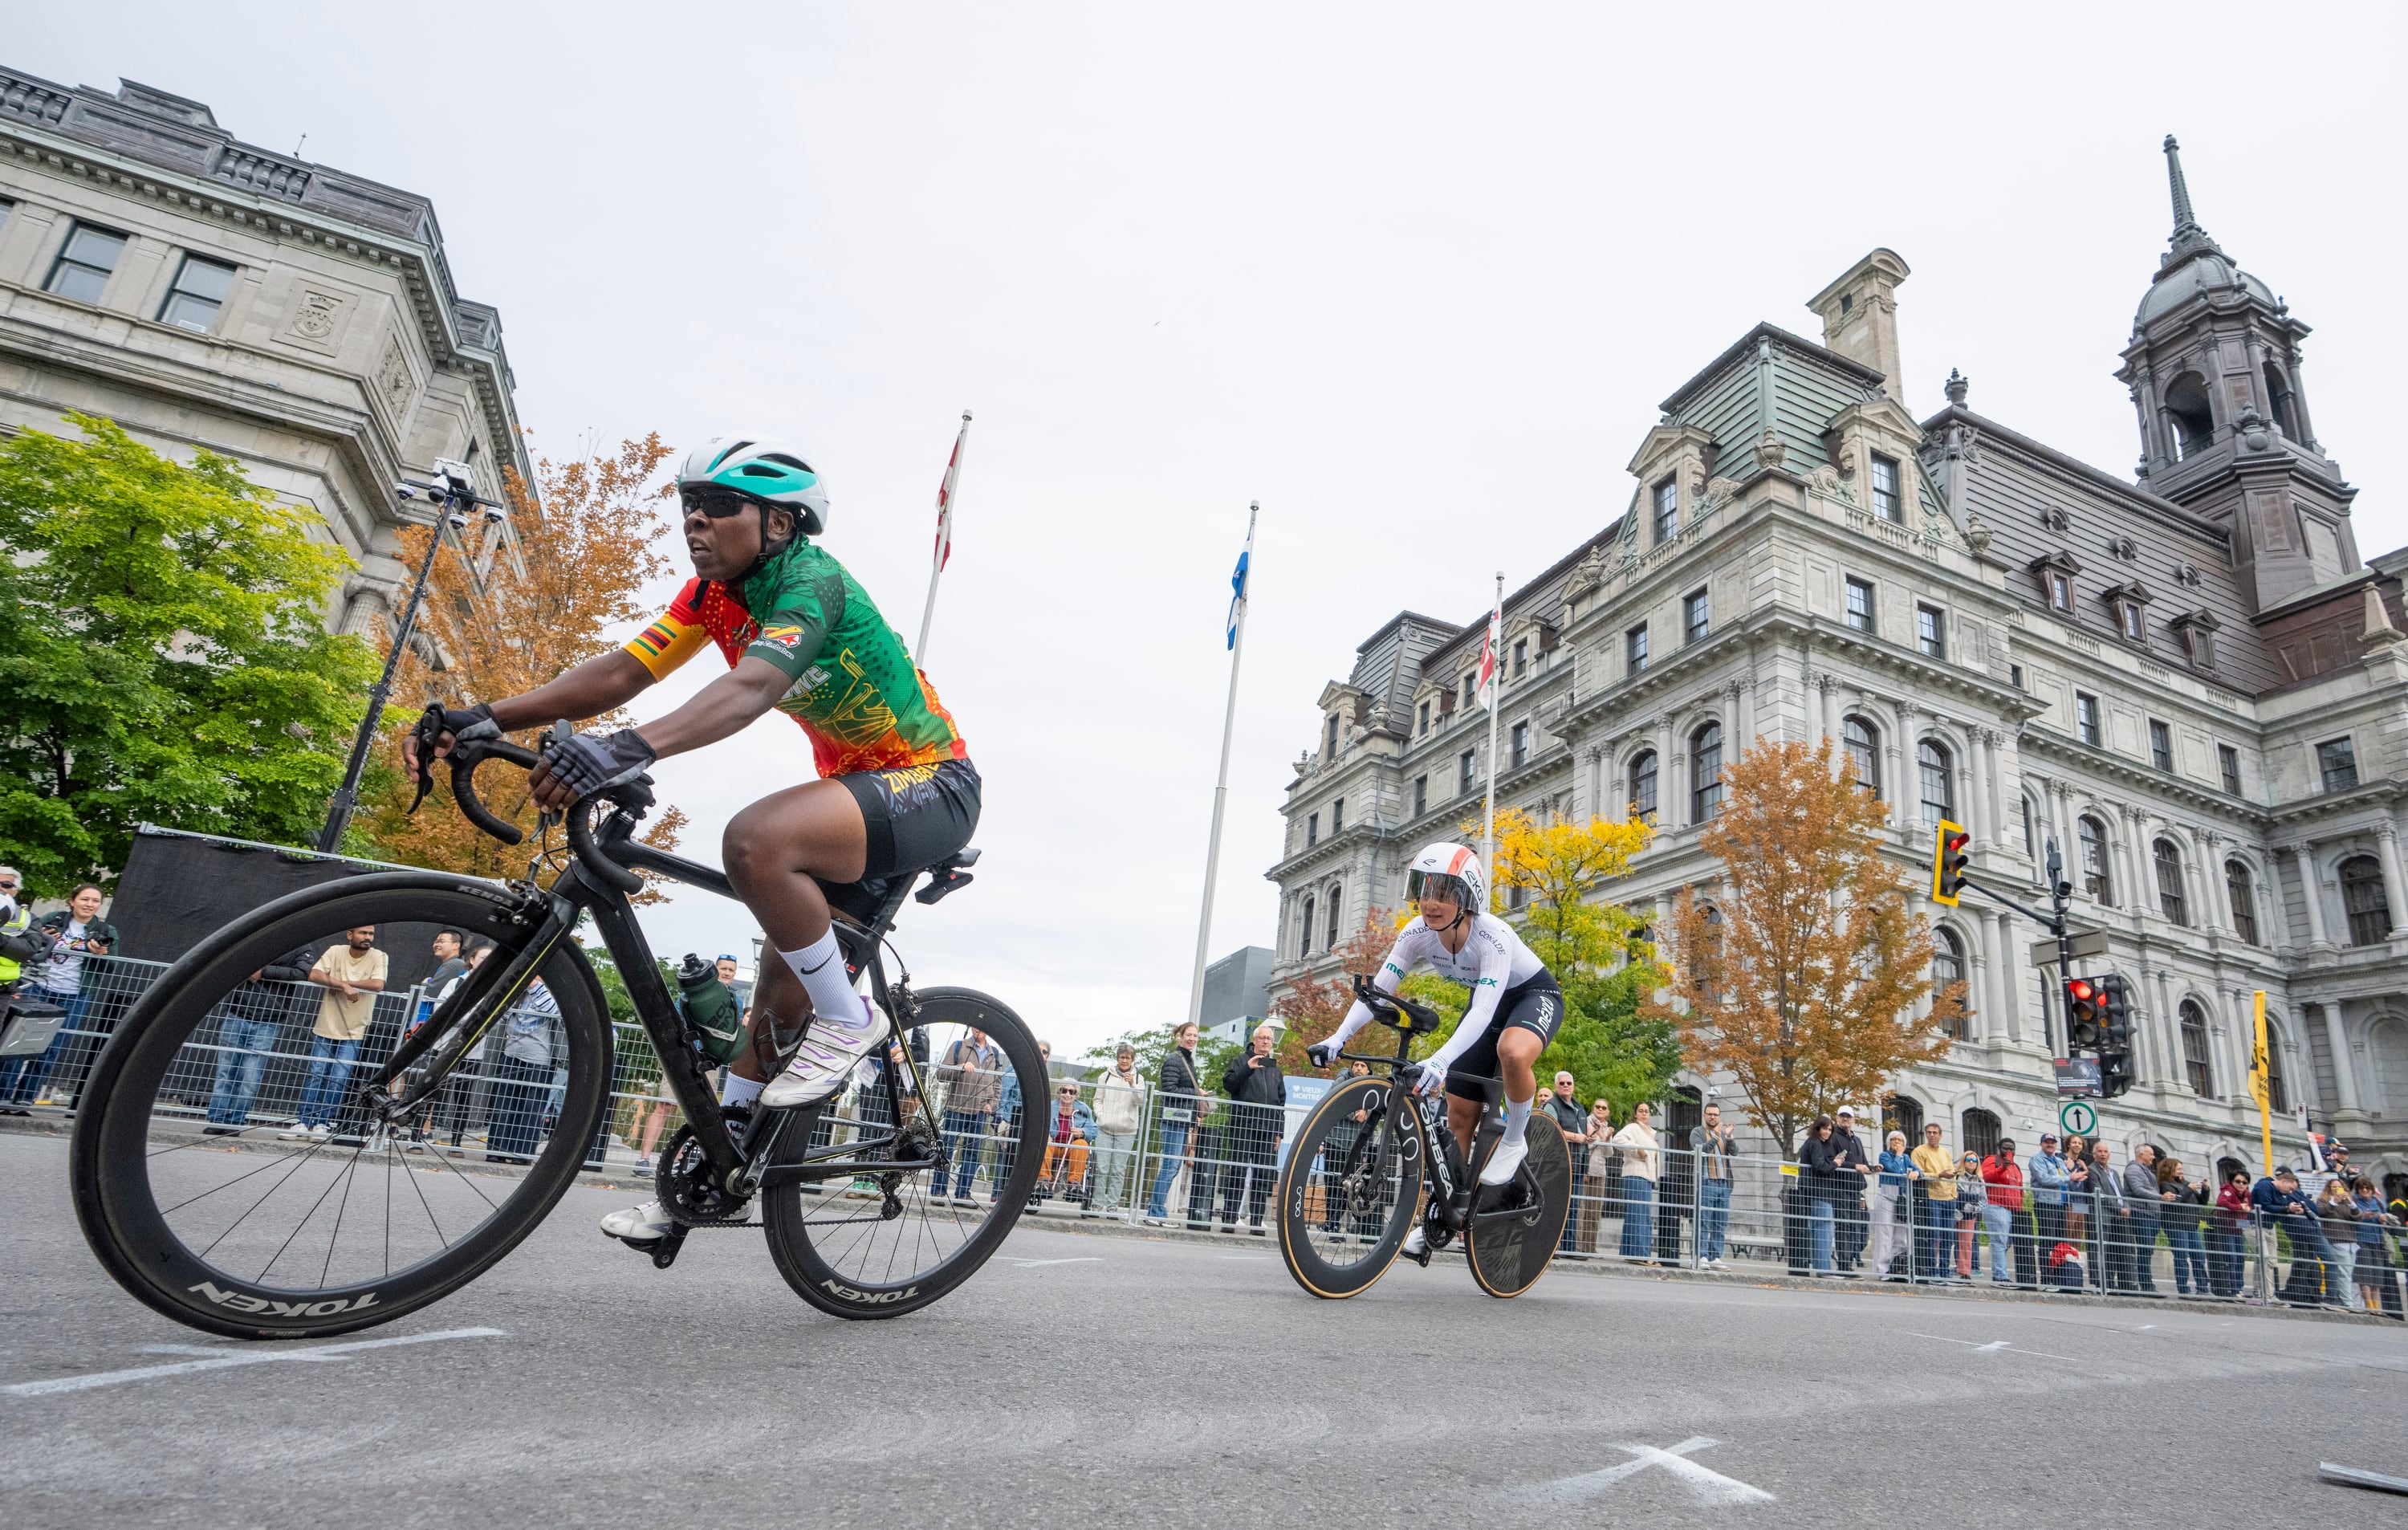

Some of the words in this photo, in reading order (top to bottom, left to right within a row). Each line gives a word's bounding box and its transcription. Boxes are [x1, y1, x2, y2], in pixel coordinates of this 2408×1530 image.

[1397, 926, 1430, 942] CONADE
[1479, 930, 1506, 955] CONADE
[1385, 962, 1405, 980] ME
[1302, 1085, 1324, 1094] VIEUX-
[1419, 1101, 1454, 1201] ORBEA
[187, 1281, 380, 1317] TOKEN
[820, 1279, 919, 1304] TOKEN
